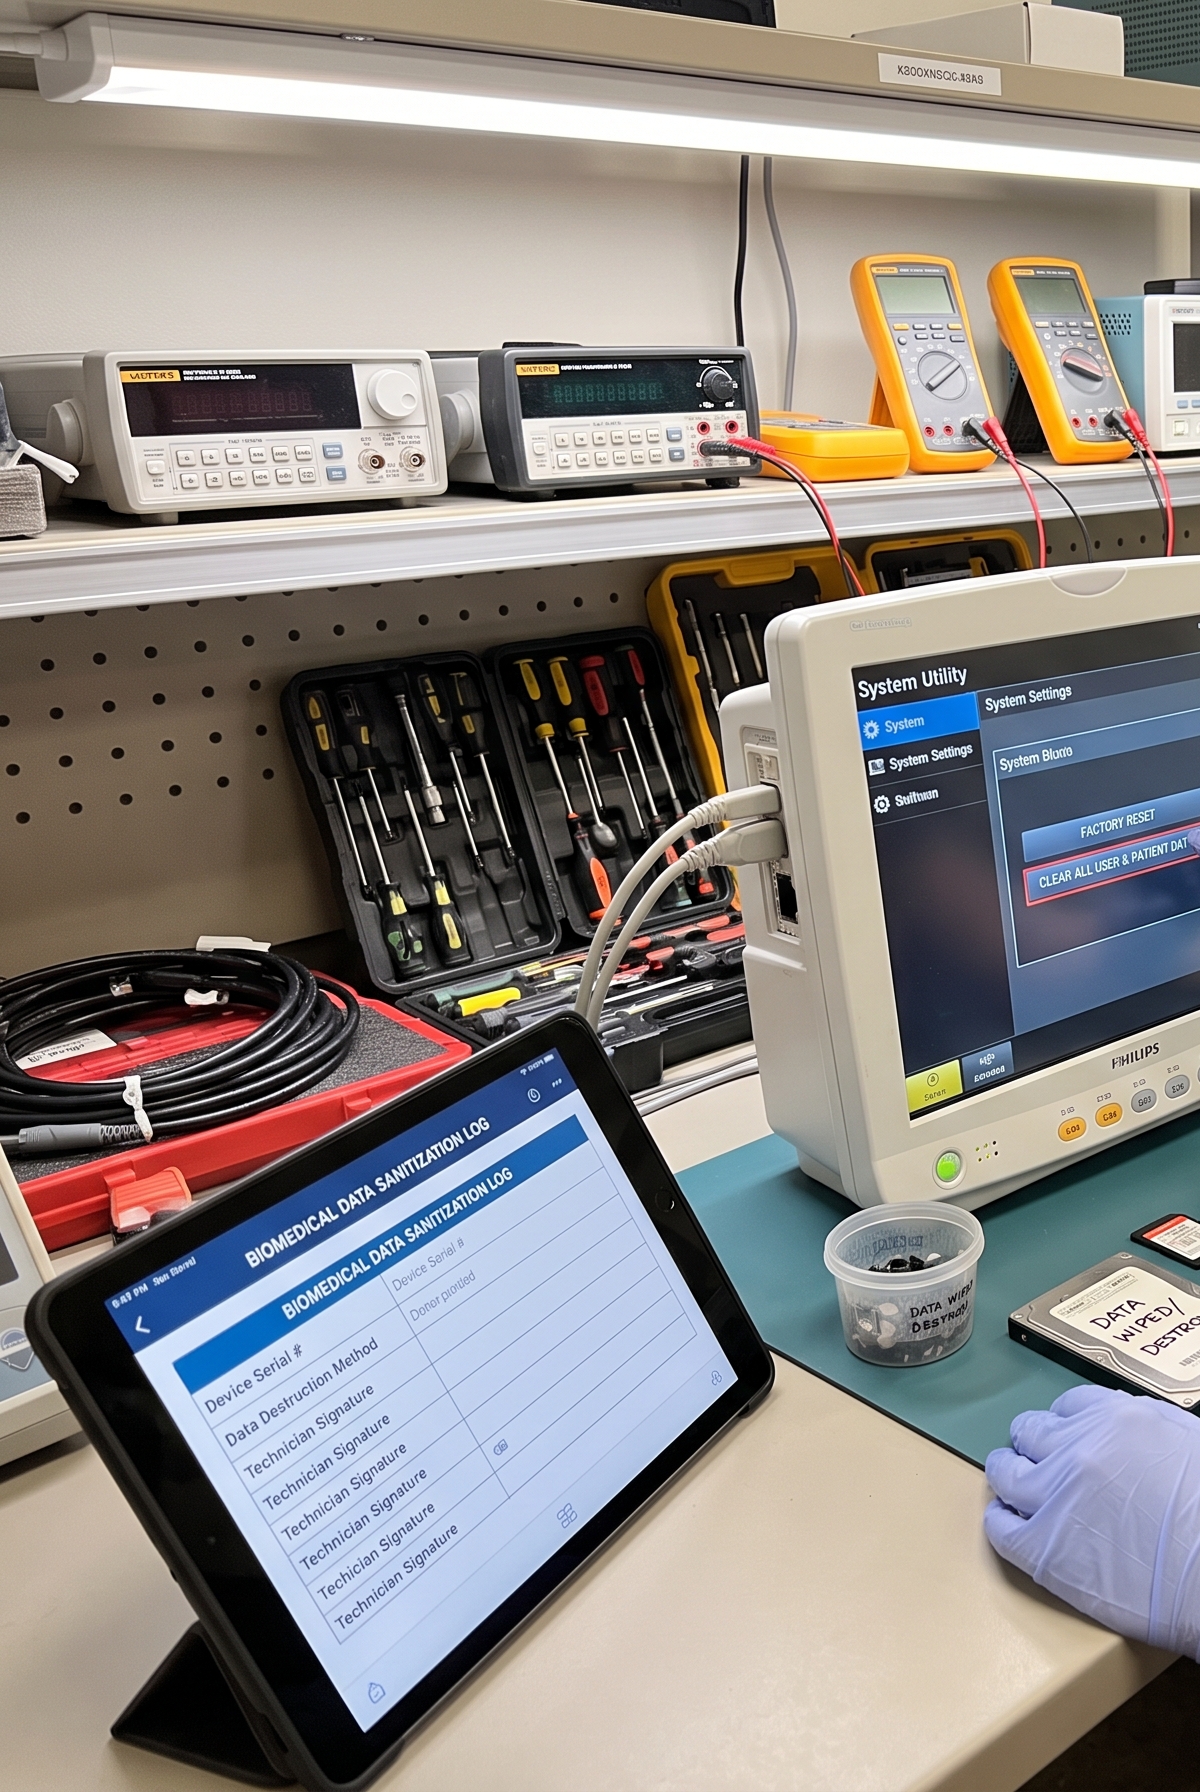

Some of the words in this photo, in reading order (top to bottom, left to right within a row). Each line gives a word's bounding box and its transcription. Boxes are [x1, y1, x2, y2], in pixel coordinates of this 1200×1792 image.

[857, 675, 918, 701] System
[921, 665, 968, 687] Utility
[985, 692, 1027, 714] System
[1028, 684, 1073, 705] Settings
[884, 714, 925, 734] System
[889, 752, 929, 772] System
[931, 743, 973, 763] Settings
[1000, 752, 1040, 773] System
[1080, 816, 1125, 840] FACTORY
[1126, 808, 1156, 828] RESET
[1039, 869, 1072, 889] CLEAR
[1074, 864, 1094, 881] ALL
[1094, 855, 1121, 874] USER
[1121, 854, 1130, 866] &
[1131, 842, 1169, 863] PATIENT
[1170, 836, 1188, 852] DAT
[244, 1206, 340, 1269] BIOMEDICAL
[336, 1184, 377, 1215] DATA
[374, 1131, 465, 1193] SANITIZATION
[462, 1116, 491, 1141] LOG
[281, 1257, 371, 1320] BIOMEDICAL
[368, 1235, 406, 1266] DATA
[404, 1181, 489, 1243] SANITIZATION
[486, 1166, 514, 1191] LOG
[909, 1301, 943, 1319] DATA
[1089, 1299, 1146, 1330] DATA
[1112, 1297, 1186, 1343] WIPED/
[204, 1377, 254, 1414] Device
[253, 1350, 293, 1383] Serial
[293, 1343, 303, 1358] #
[224, 1420, 260, 1447] Data
[258, 1371, 334, 1425] Destruction
[331, 1336, 379, 1376] Method
[243, 1425, 317, 1479] Technician
[315, 1383, 375, 1431] Signature
[262, 1456, 334, 1511] Technician
[332, 1413, 391, 1461] Signature
[280, 1486, 350, 1542] Technician
[349, 1442, 408, 1491] Signature
[298, 1513, 371, 1571] Technician
[369, 1468, 428, 1517] Signature
[316, 1548, 380, 1601] Techician
[378, 1502, 436, 1552] Signature
[333, 1570, 404, 1630] Technician
[402, 1523, 459, 1574] Signature
